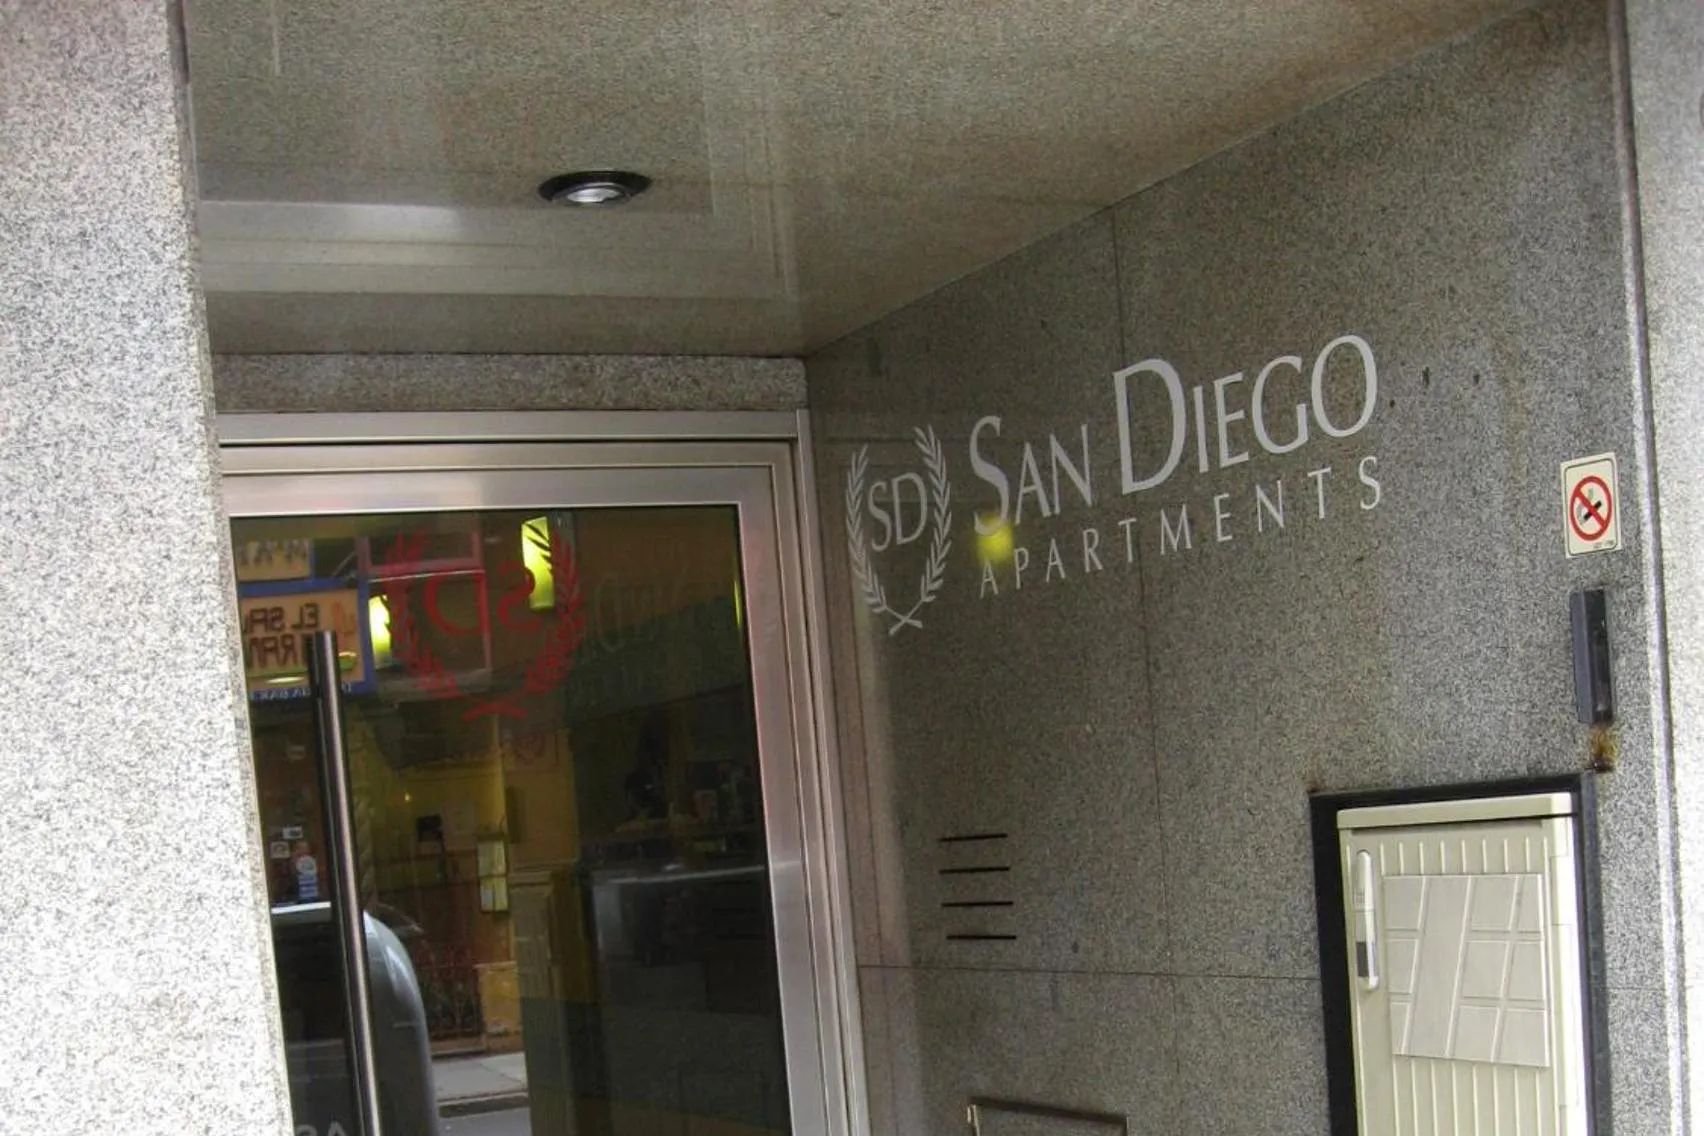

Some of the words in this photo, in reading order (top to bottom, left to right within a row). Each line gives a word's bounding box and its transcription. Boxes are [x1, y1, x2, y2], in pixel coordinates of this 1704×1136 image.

[969, 415, 1094, 536] SAN
[1112, 334, 1379, 495] DIEGO
[867, 471, 928, 552] SD
[979, 456, 1382, 599] APARTMENTS
